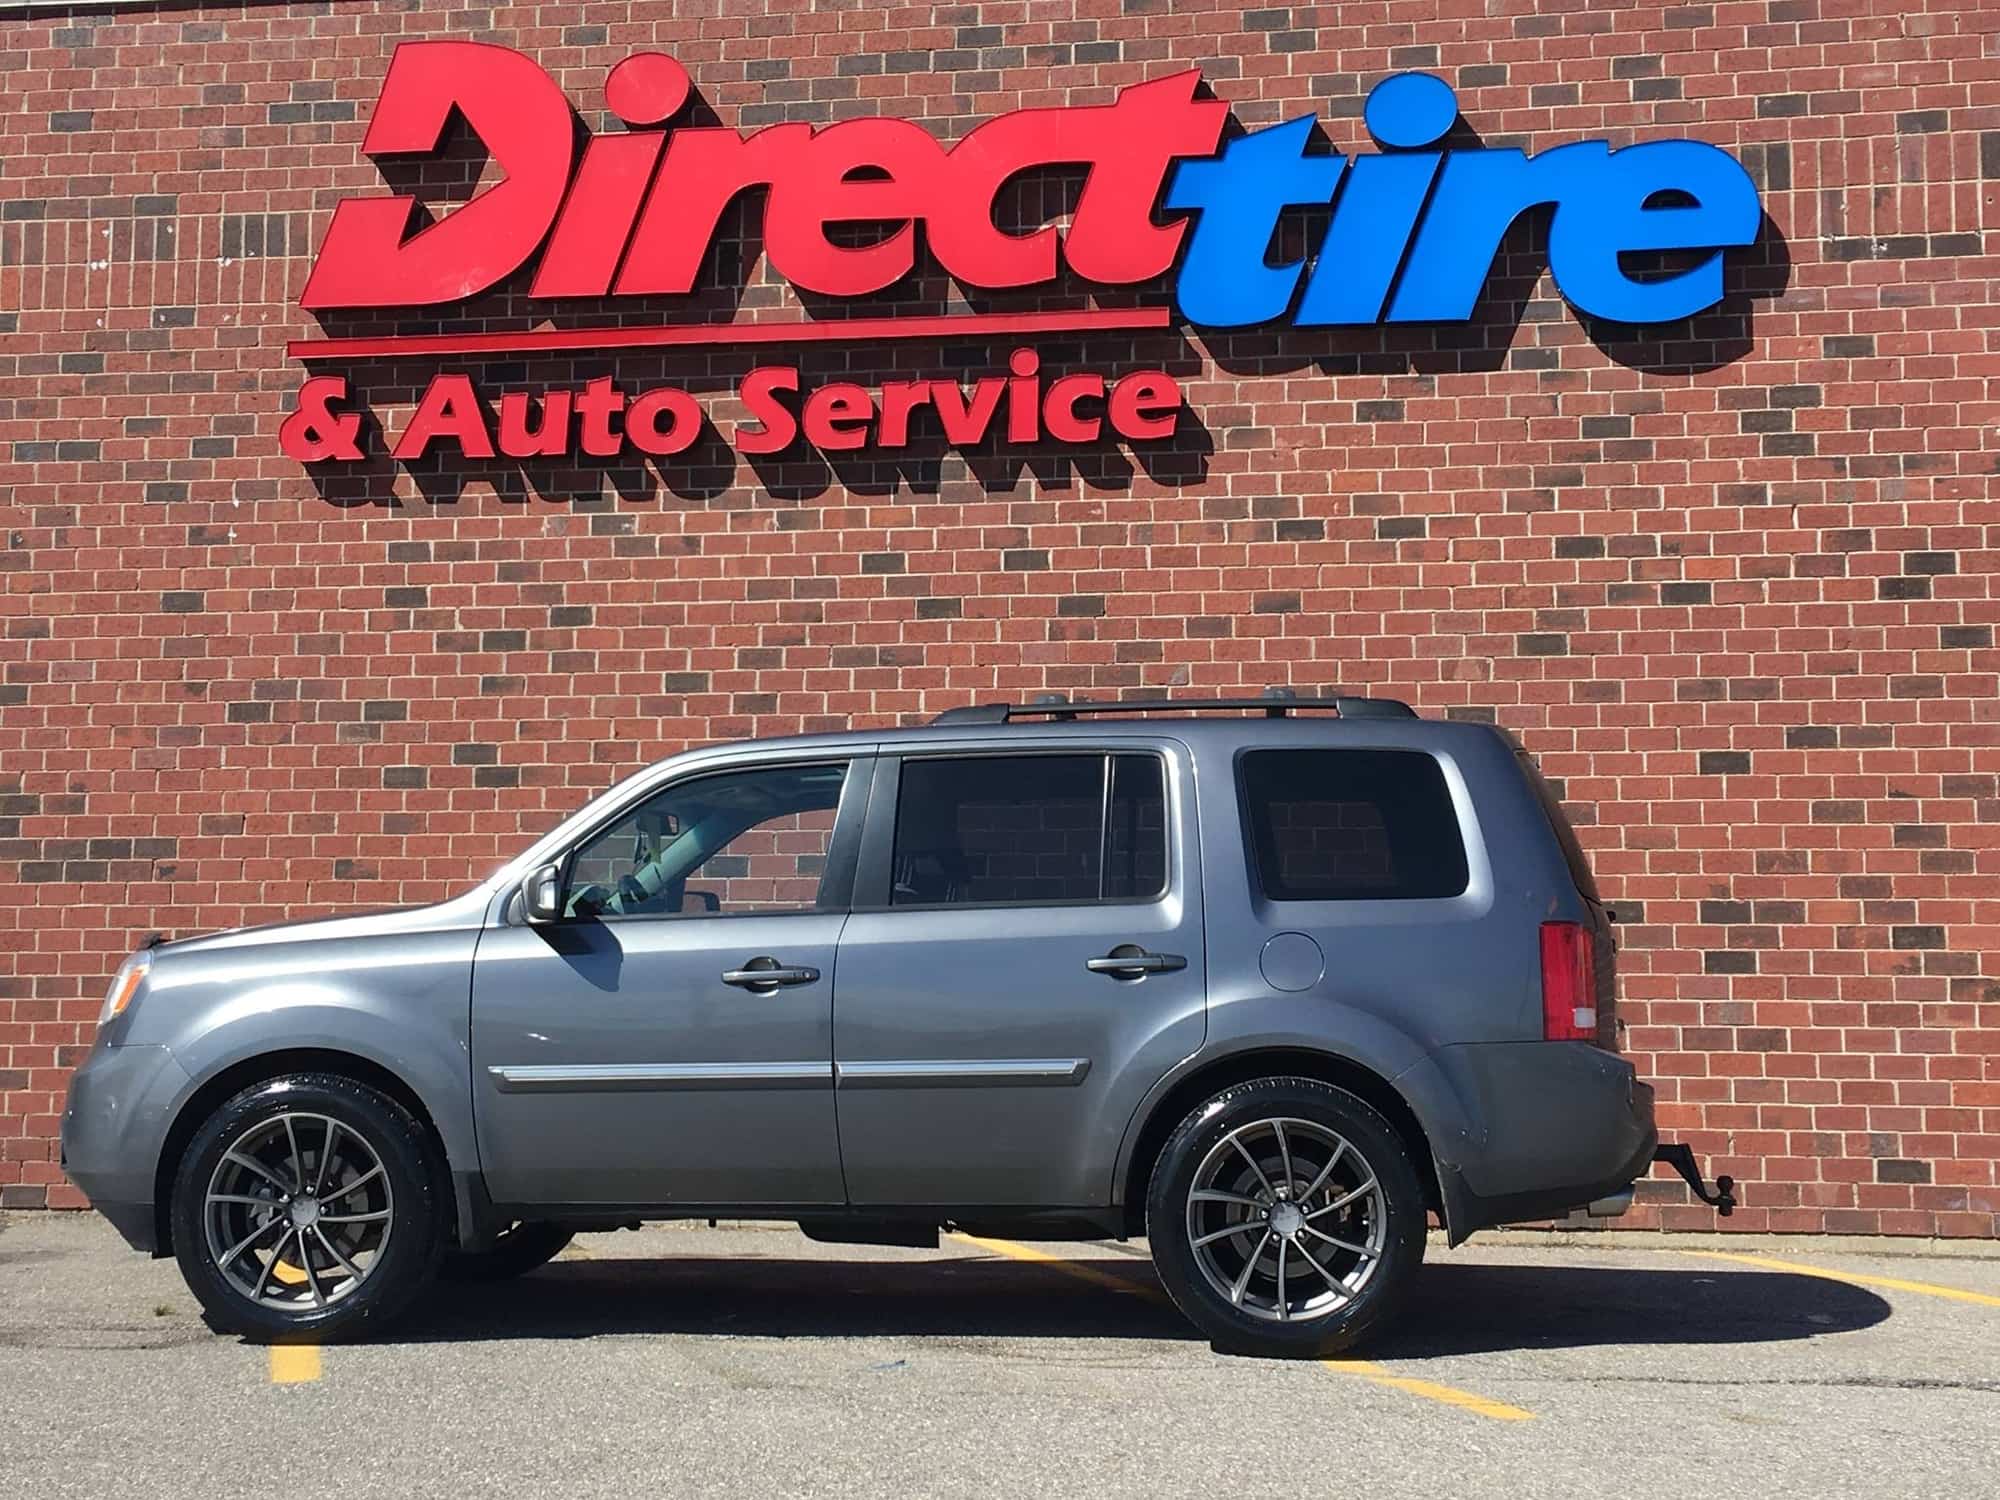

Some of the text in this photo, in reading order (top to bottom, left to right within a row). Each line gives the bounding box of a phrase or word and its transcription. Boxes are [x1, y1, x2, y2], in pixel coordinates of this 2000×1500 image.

[300, 41, 1762, 327] Direct tire
[279, 347, 1183, 463] & Auto Service
